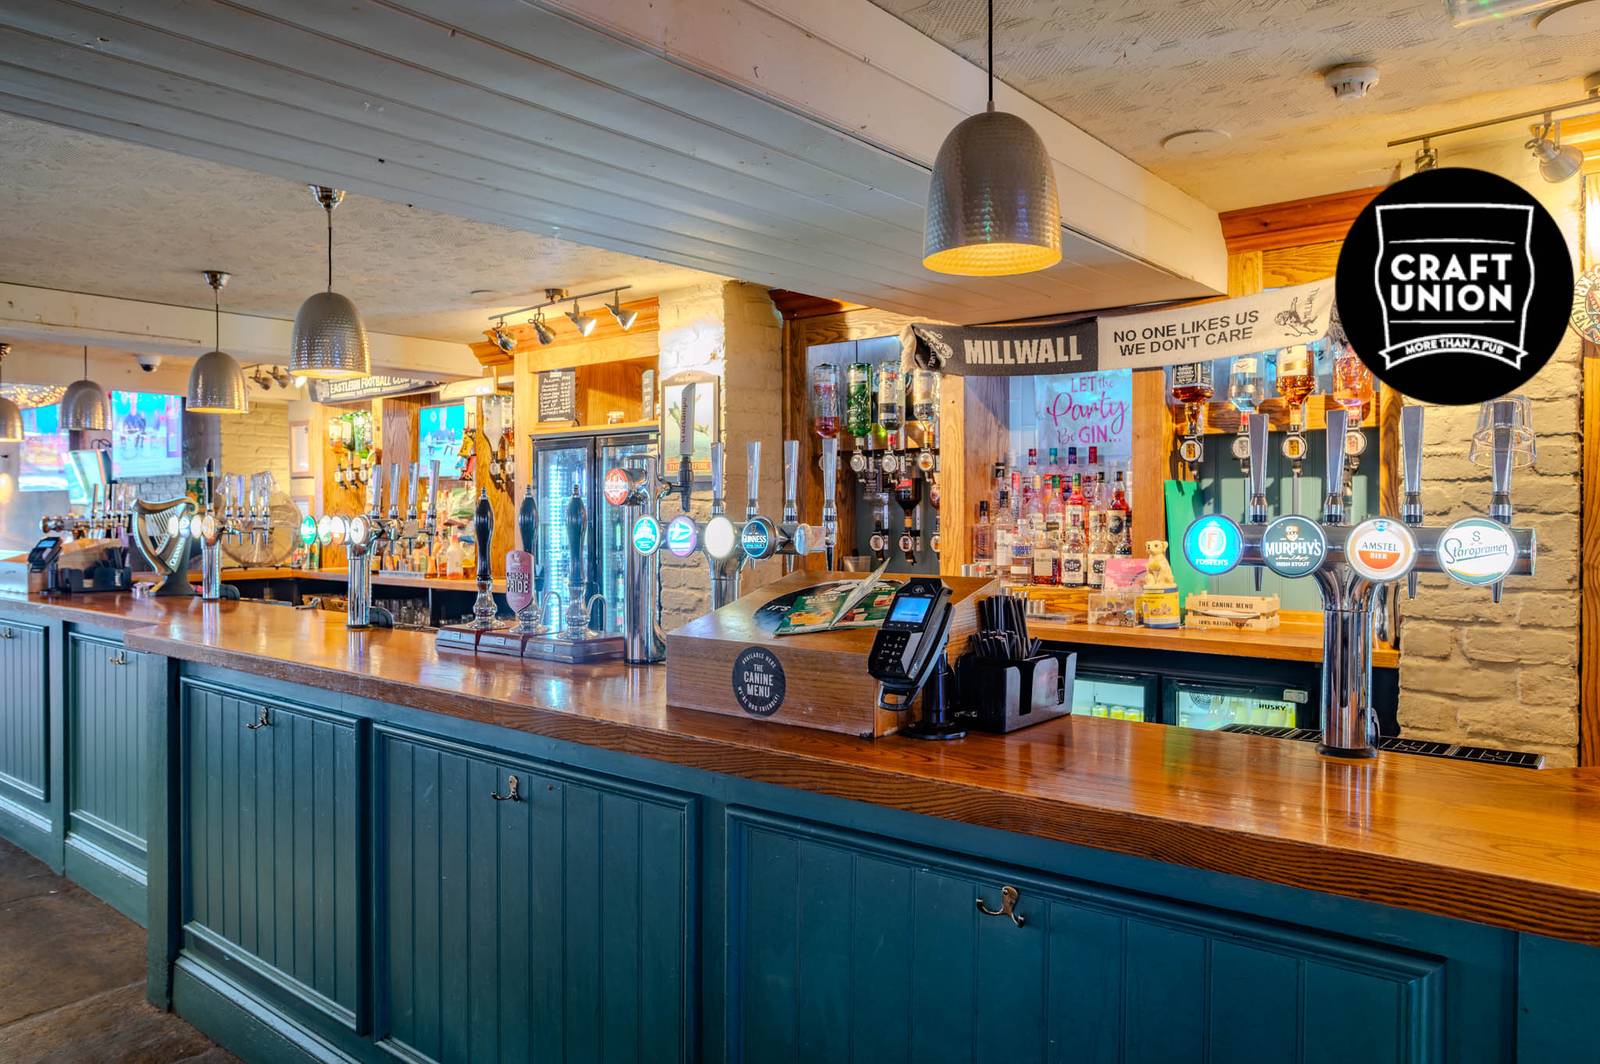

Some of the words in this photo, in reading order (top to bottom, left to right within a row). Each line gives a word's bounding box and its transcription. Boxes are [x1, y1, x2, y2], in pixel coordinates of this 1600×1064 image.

[1114, 330, 1136, 343] NO
[1142, 324, 1176, 339] ONE
[1181, 316, 1230, 335] LIKES
[1235, 310, 1260, 325] US
[963, 335, 1083, 365] MILLWALL
[1120, 342, 1146, 357] WE
[1150, 335, 1200, 353] DON'T
[1205, 326, 1254, 345] CARE
[1071, 376, 1097, 393] LET
[1046, 391, 1130, 434] Party
[743, 535, 768, 543] GUINNESS
[1361, 541, 1398, 552] AMSTEL
[1265, 539, 1322, 557] MURPHY'S
[1444, 537, 1509, 564] Staropramen
[753, 663, 764, 672] THE
[743, 671, 774, 686] CANINE
[746, 683, 770, 698] MENU
[1258, 703, 1287, 711] HUSKY
